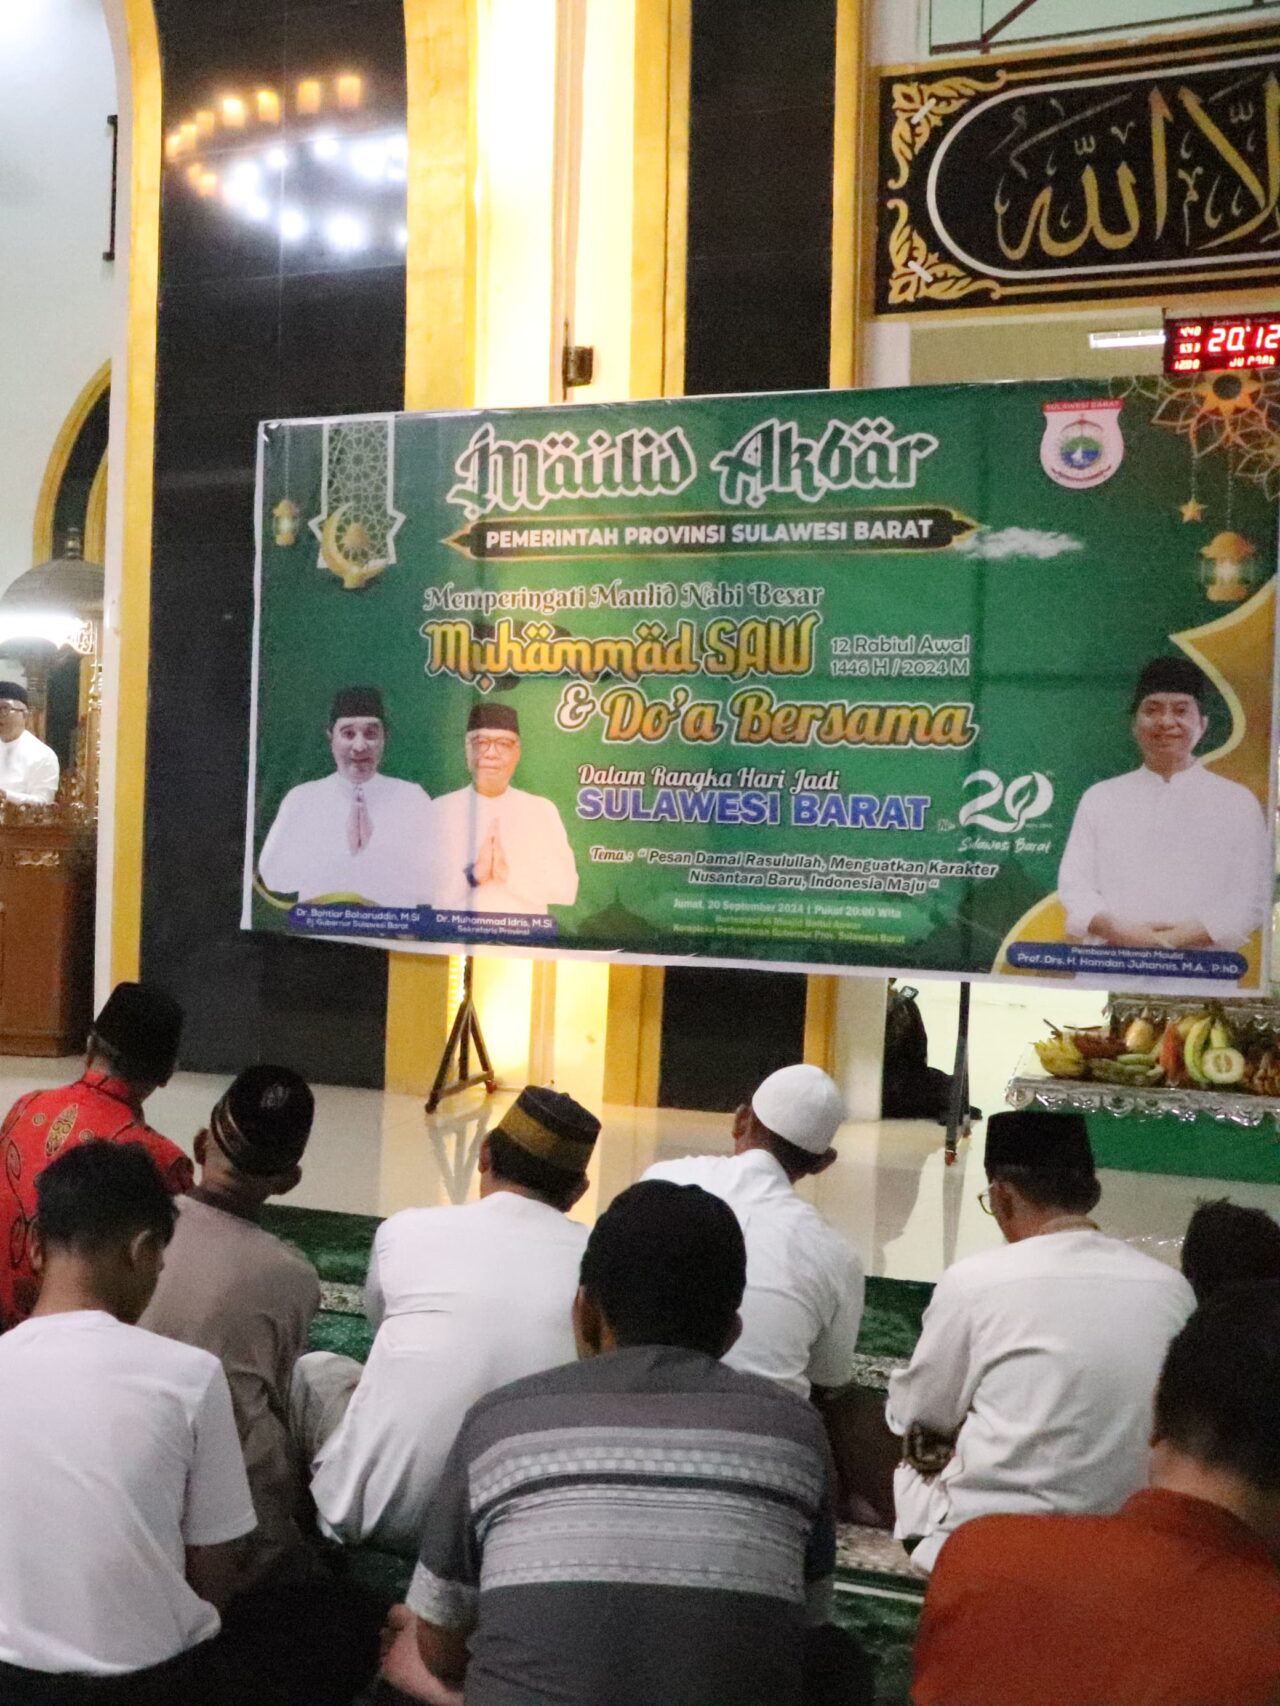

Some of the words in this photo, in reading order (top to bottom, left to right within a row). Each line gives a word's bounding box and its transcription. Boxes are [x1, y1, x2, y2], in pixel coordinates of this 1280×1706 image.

[486, 528, 618, 549] PEMERINTAH
[624, 525, 726, 544] PROVINSI
[731, 522, 847, 543] SULAWESI
[854, 519, 933, 540] BARAT
[423, 582, 586, 616] Memperingati
[589, 579, 677, 608] Maulid
[682, 582, 744, 610] Nabi
[747, 581, 825, 608] Besar
[704, 611, 821, 682] SAW
[831, 637, 851, 655] 12
[853, 634, 916, 655] Rabiul
[918, 634, 970, 655] Awal
[831, 658, 869, 676] 1446
[871, 657, 889, 676] H
[891, 657, 901, 677] /
[902, 659, 948, 676] 2024
[950, 657, 970, 676] M
[555, 683, 596, 731] &
[730, 687, 980, 750] Bersama
[578, 763, 645, 785] Dalam
[651, 765, 732, 793] Rangka
[737, 767, 786, 789] Hari
[790, 769, 840, 795] Jadi
[576, 786, 781, 825] SULAWESI
[792, 793, 931, 831] BARAT
[959, 769, 1054, 833] 20
[648, 849, 692, 865] Pesan
[694, 850, 741, 867] Damai
[744, 852, 827, 871] Rasulullah,
[830, 855, 924, 875] Menguatkan
[927, 860, 999, 878] Karakter
[688, 868, 764, 886] Nusantara
[766, 872, 807, 889] Baru,
[809, 874, 884, 890] Indonesia
[886, 877, 926, 895] Maju
[452, 916, 505, 926] Muhammad
[1080, 958, 1125, 968] Hamdan
